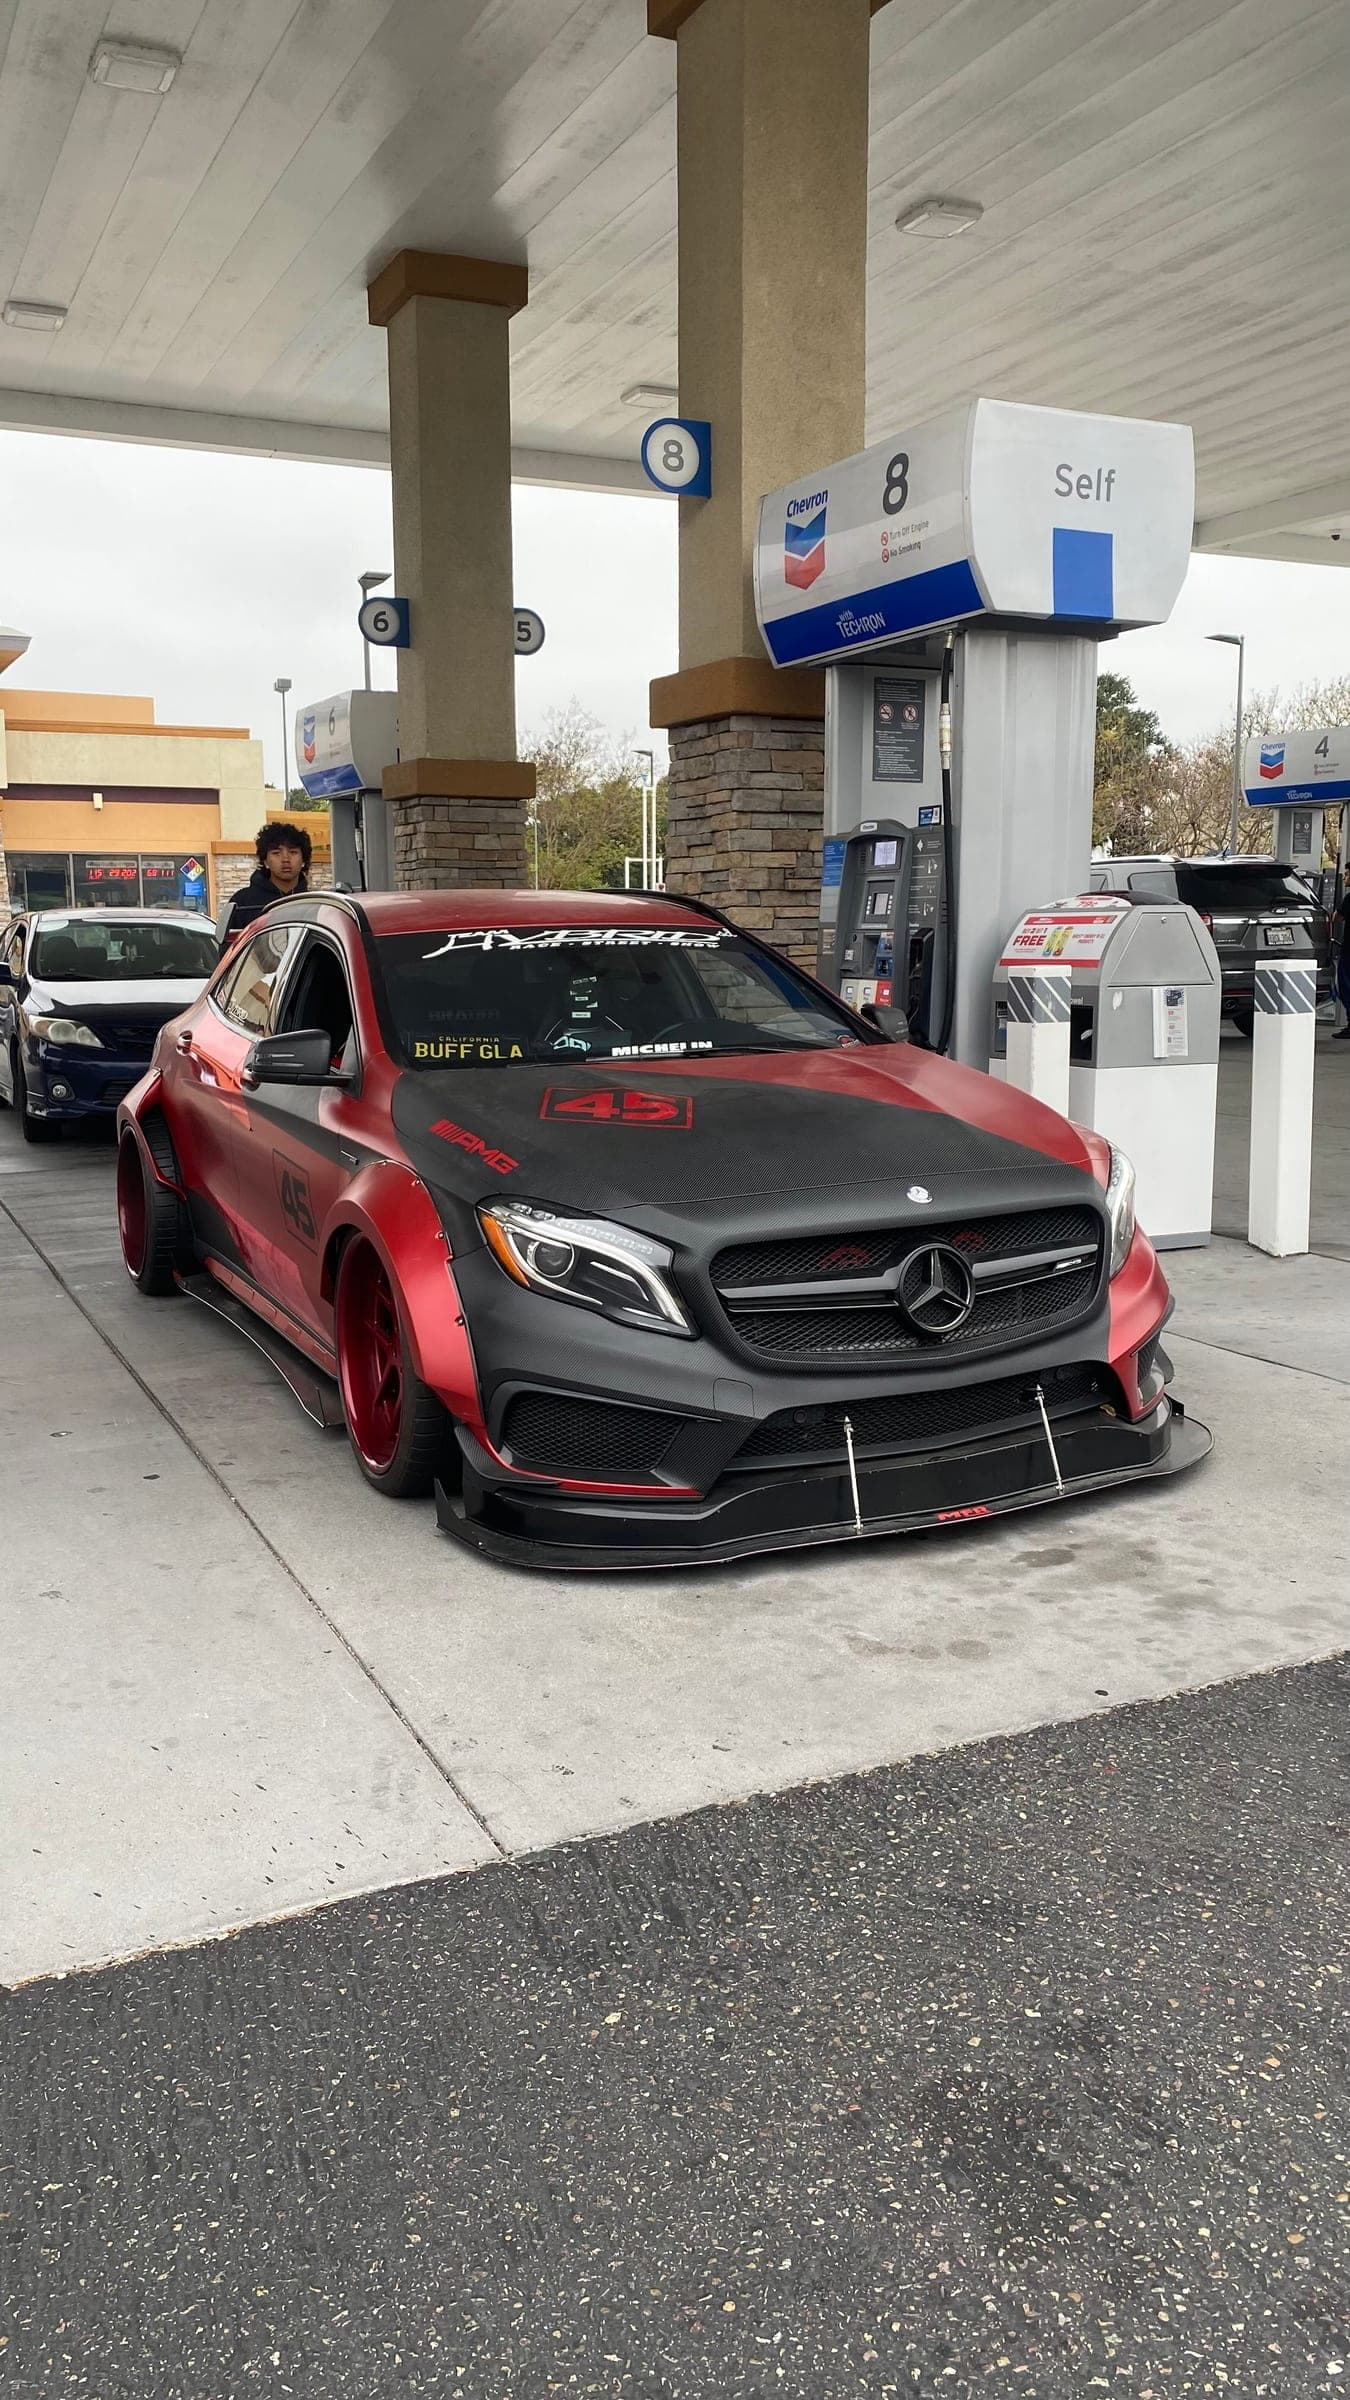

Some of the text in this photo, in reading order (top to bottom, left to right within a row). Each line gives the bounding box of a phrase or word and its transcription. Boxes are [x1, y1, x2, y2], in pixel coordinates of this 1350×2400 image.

[662, 439, 684, 472] 8
[882, 452, 910, 515] 8
[1054, 463, 1116, 502] Self
[786, 489, 829, 518] Chevron
[911, 520, 929, 532] Engine
[898, 541, 921, 555] Smoking
[373, 610, 389, 632] 6
[836, 611, 886, 639] TECHRON
[838, 609, 855, 622] with
[517, 620, 531, 642] 5
[328, 706, 336, 736] 6
[1261, 742, 1286, 751] Chevron
[1314, 735, 1330, 758] 4
[509, 942, 561, 950] RACE
[1012, 935, 1047, 946] FREE
[438, 1035, 500, 1043] CALIFORNIA
[414, 1042, 524, 1060] BUFF GLA
[553, 1092, 680, 1122] 45
[281, 1169, 316, 1239] 45
